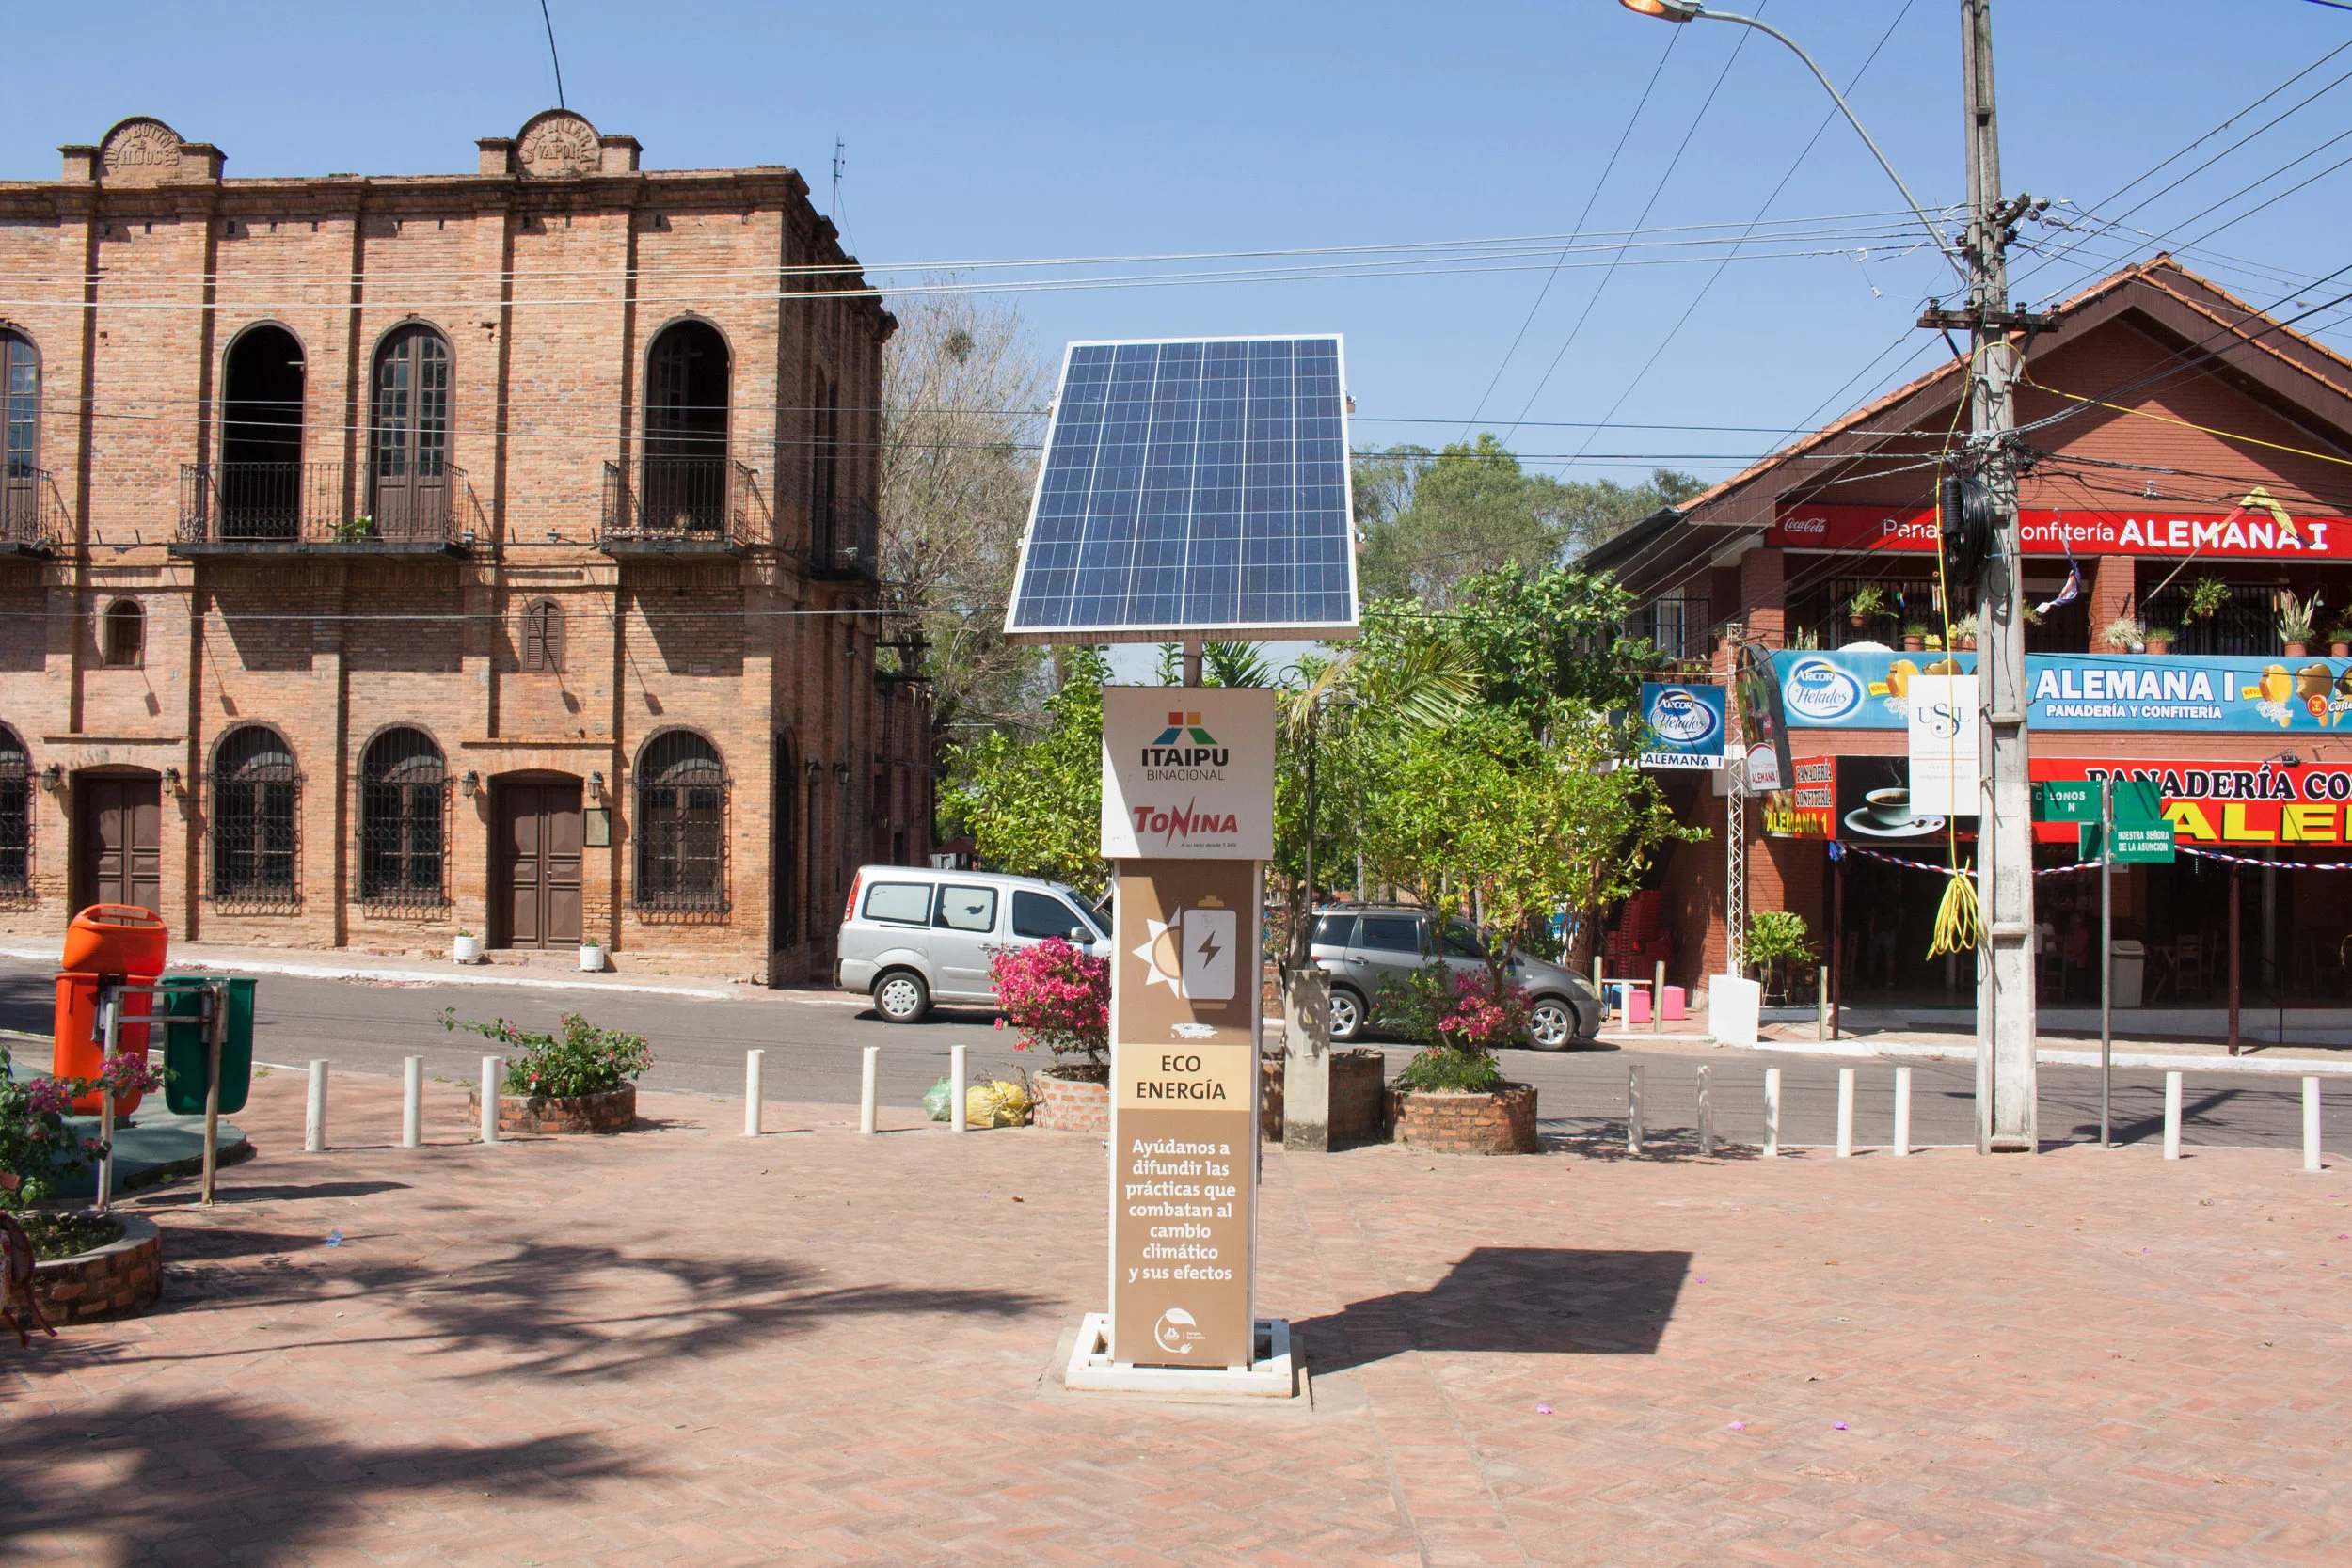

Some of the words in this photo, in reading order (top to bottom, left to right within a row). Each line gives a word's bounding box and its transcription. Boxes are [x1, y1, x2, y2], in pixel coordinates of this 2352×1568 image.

[120, 150, 164, 166] HIJOS
[536, 141, 580, 160] VAPOR
[1883, 519, 1943, 539] Pana
[2020, 521, 2115, 542] onfitería
[2118, 518, 2303, 550] ALEMANA
[2308, 523, 2328, 550] I
[1795, 669, 1836, 682] ARCOR
[2035, 668, 2215, 702] ALEMANA
[2223, 670, 2235, 703] I
[1658, 697, 1693, 710] ARCOR
[1795, 688, 1848, 705] Helados
[2045, 700, 2127, 718] PANADERÍA
[2129, 704, 2138, 718] Y
[2140, 703, 2223, 720] CONFITERÍA
[1658, 713, 1706, 730] Helados
[1141, 748, 1229, 767] ITAIPU
[1645, 753, 1709, 768] ALEMANA
[1147, 769, 1225, 781] BINACIONAL
[1751, 770, 1776, 784] ALEMANA
[1795, 758, 1833, 783] PANADERÍA
[2302, 771, 2352, 801] CO
[1795, 784, 1833, 808] CONFITERÍA
[1766, 811, 1819, 833] ALEMANA
[2161, 801, 2352, 841] ALE
[2118, 831, 2145, 840] NUESTRA
[2146, 829, 2170, 840] SEÑORA
[2118, 843, 2127, 851] DE
[2128, 843, 2136, 851] LA
[1162, 1054, 1201, 1072] ECO
[1136, 1079, 1227, 1101] ENERGÍA
[1132, 1139, 1216, 1159] Ayúdanos
[1220, 1143, 1231, 1156] a
[1133, 1160, 1202, 1177] difundir
[1205, 1161, 1230, 1177] las
[1126, 1180, 1200, 1200] prácticas
[1204, 1183, 1236, 1202] que
[1129, 1202, 1213, 1218] combatan
[1216, 1202, 1232, 1218] al
[1150, 1223, 1212, 1239] cambio
[1142, 1243, 1218, 1259] climático
[1129, 1268, 1139, 1283] y
[1142, 1268, 1169, 1280] sus
[1173, 1264, 1232, 1280] efectos
